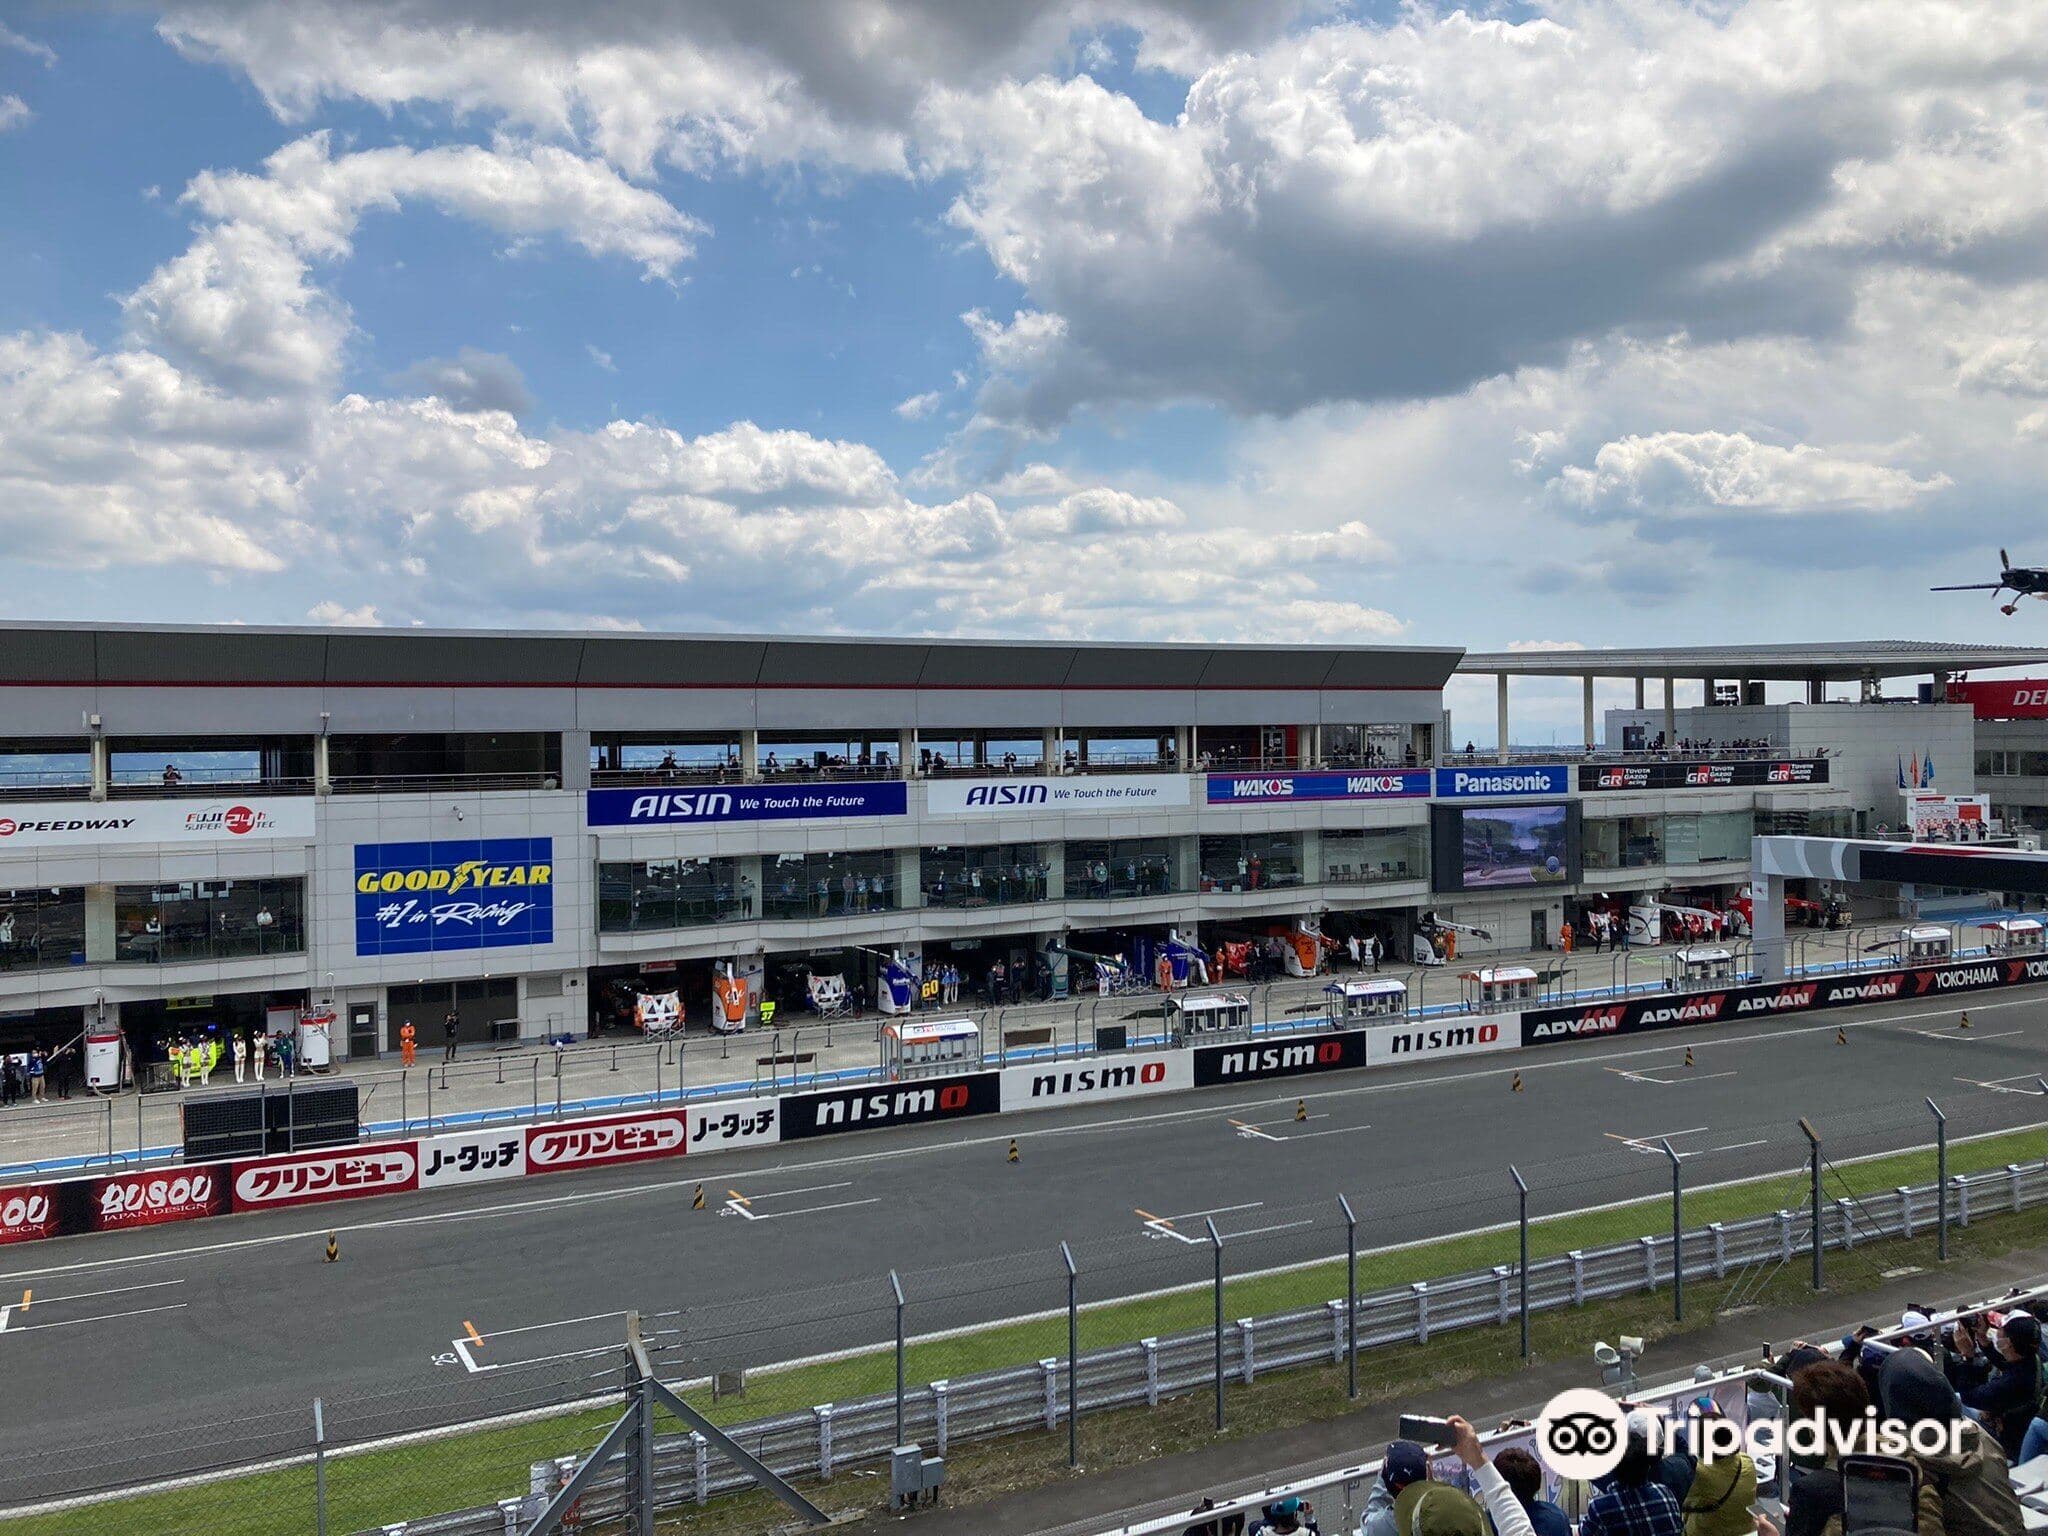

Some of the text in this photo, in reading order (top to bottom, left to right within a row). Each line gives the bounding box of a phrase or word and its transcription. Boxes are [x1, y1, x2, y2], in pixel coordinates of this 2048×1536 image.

[1455, 771, 1551, 793] Panasonic
[1600, 775, 1622, 785] GR
[1687, 772, 1708, 783] GR
[1769, 770, 1788, 780] GR
[630, 793, 865, 818] AISIN We Touch the Future
[966, 785, 1157, 806] AISIN We Touch the Future
[0, 818, 136, 834] SPEEDWAY
[186, 813, 223, 823] FUJI
[375, 900, 536, 929] #1 in Racing
[922, 980, 939, 998] 60
[1935, 967, 1999, 989] YOKOHAMA
[1737, 993, 1810, 1012] ADVAN
[1828, 982, 1896, 1001] ADVAN
[1639, 1003, 1717, 1024] ADVAN
[1533, 1015, 1616, 1037] ADVAN
[1392, 1024, 1498, 1053] nismo
[1221, 1042, 1342, 1075] nismo
[1032, 1062, 1165, 1096] nismo
[815, 1085, 969, 1126] nismo
[693, 1109, 774, 1142] ノータッチ
[541, 1128, 673, 1161] クリンビュー
[425, 1140, 519, 1176] ノータッチ
[250, 1160, 403, 1197] クリンビュー
[103, 1202, 207, 1222] JAPAN DESIGN
